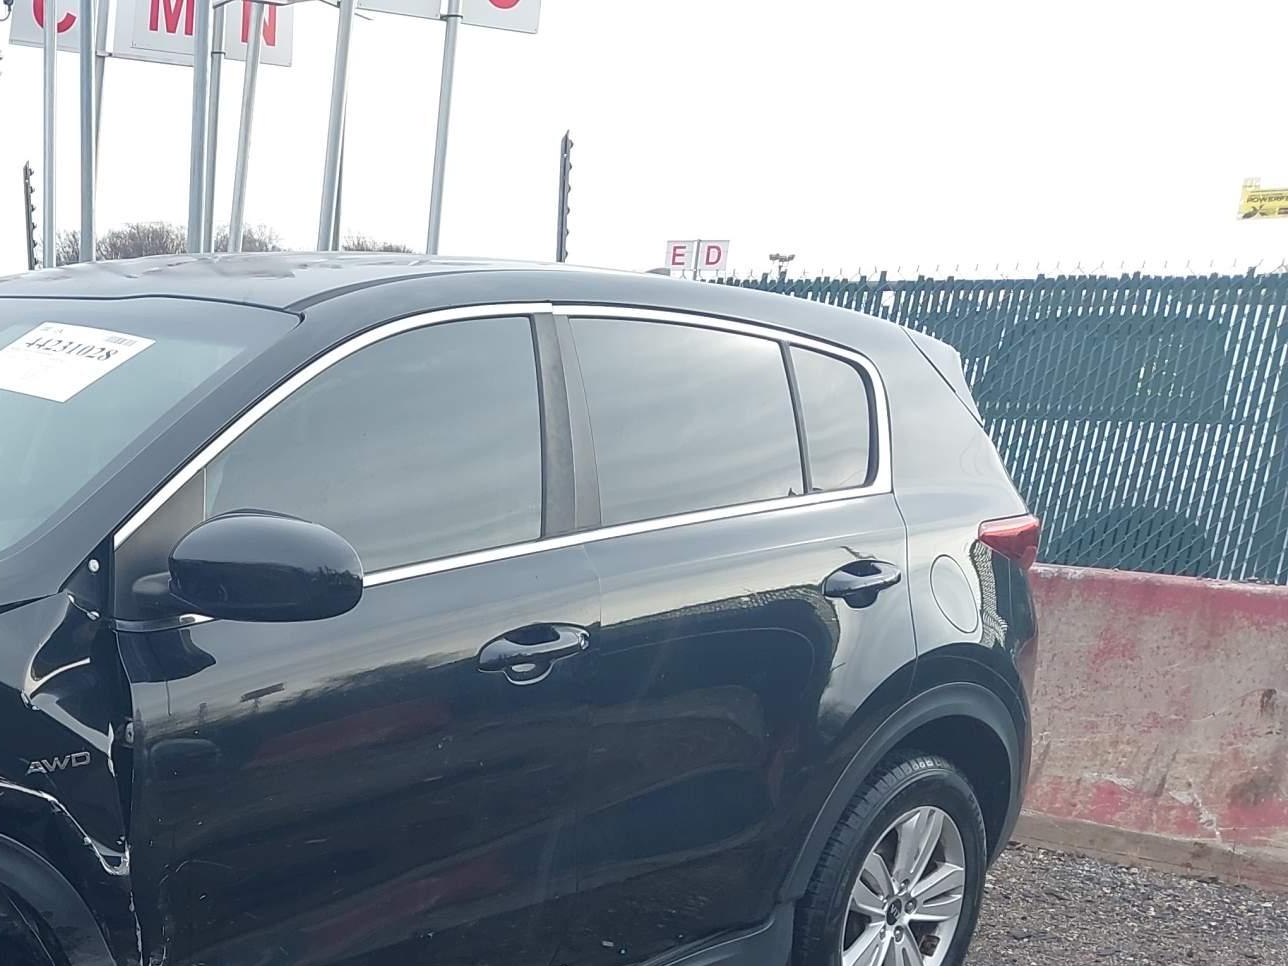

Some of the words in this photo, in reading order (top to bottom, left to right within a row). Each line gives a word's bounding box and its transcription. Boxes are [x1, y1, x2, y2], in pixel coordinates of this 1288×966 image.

[671, 245, 687, 266] E
[705, 245, 722, 266] D
[24, 751, 91, 776] AWD
